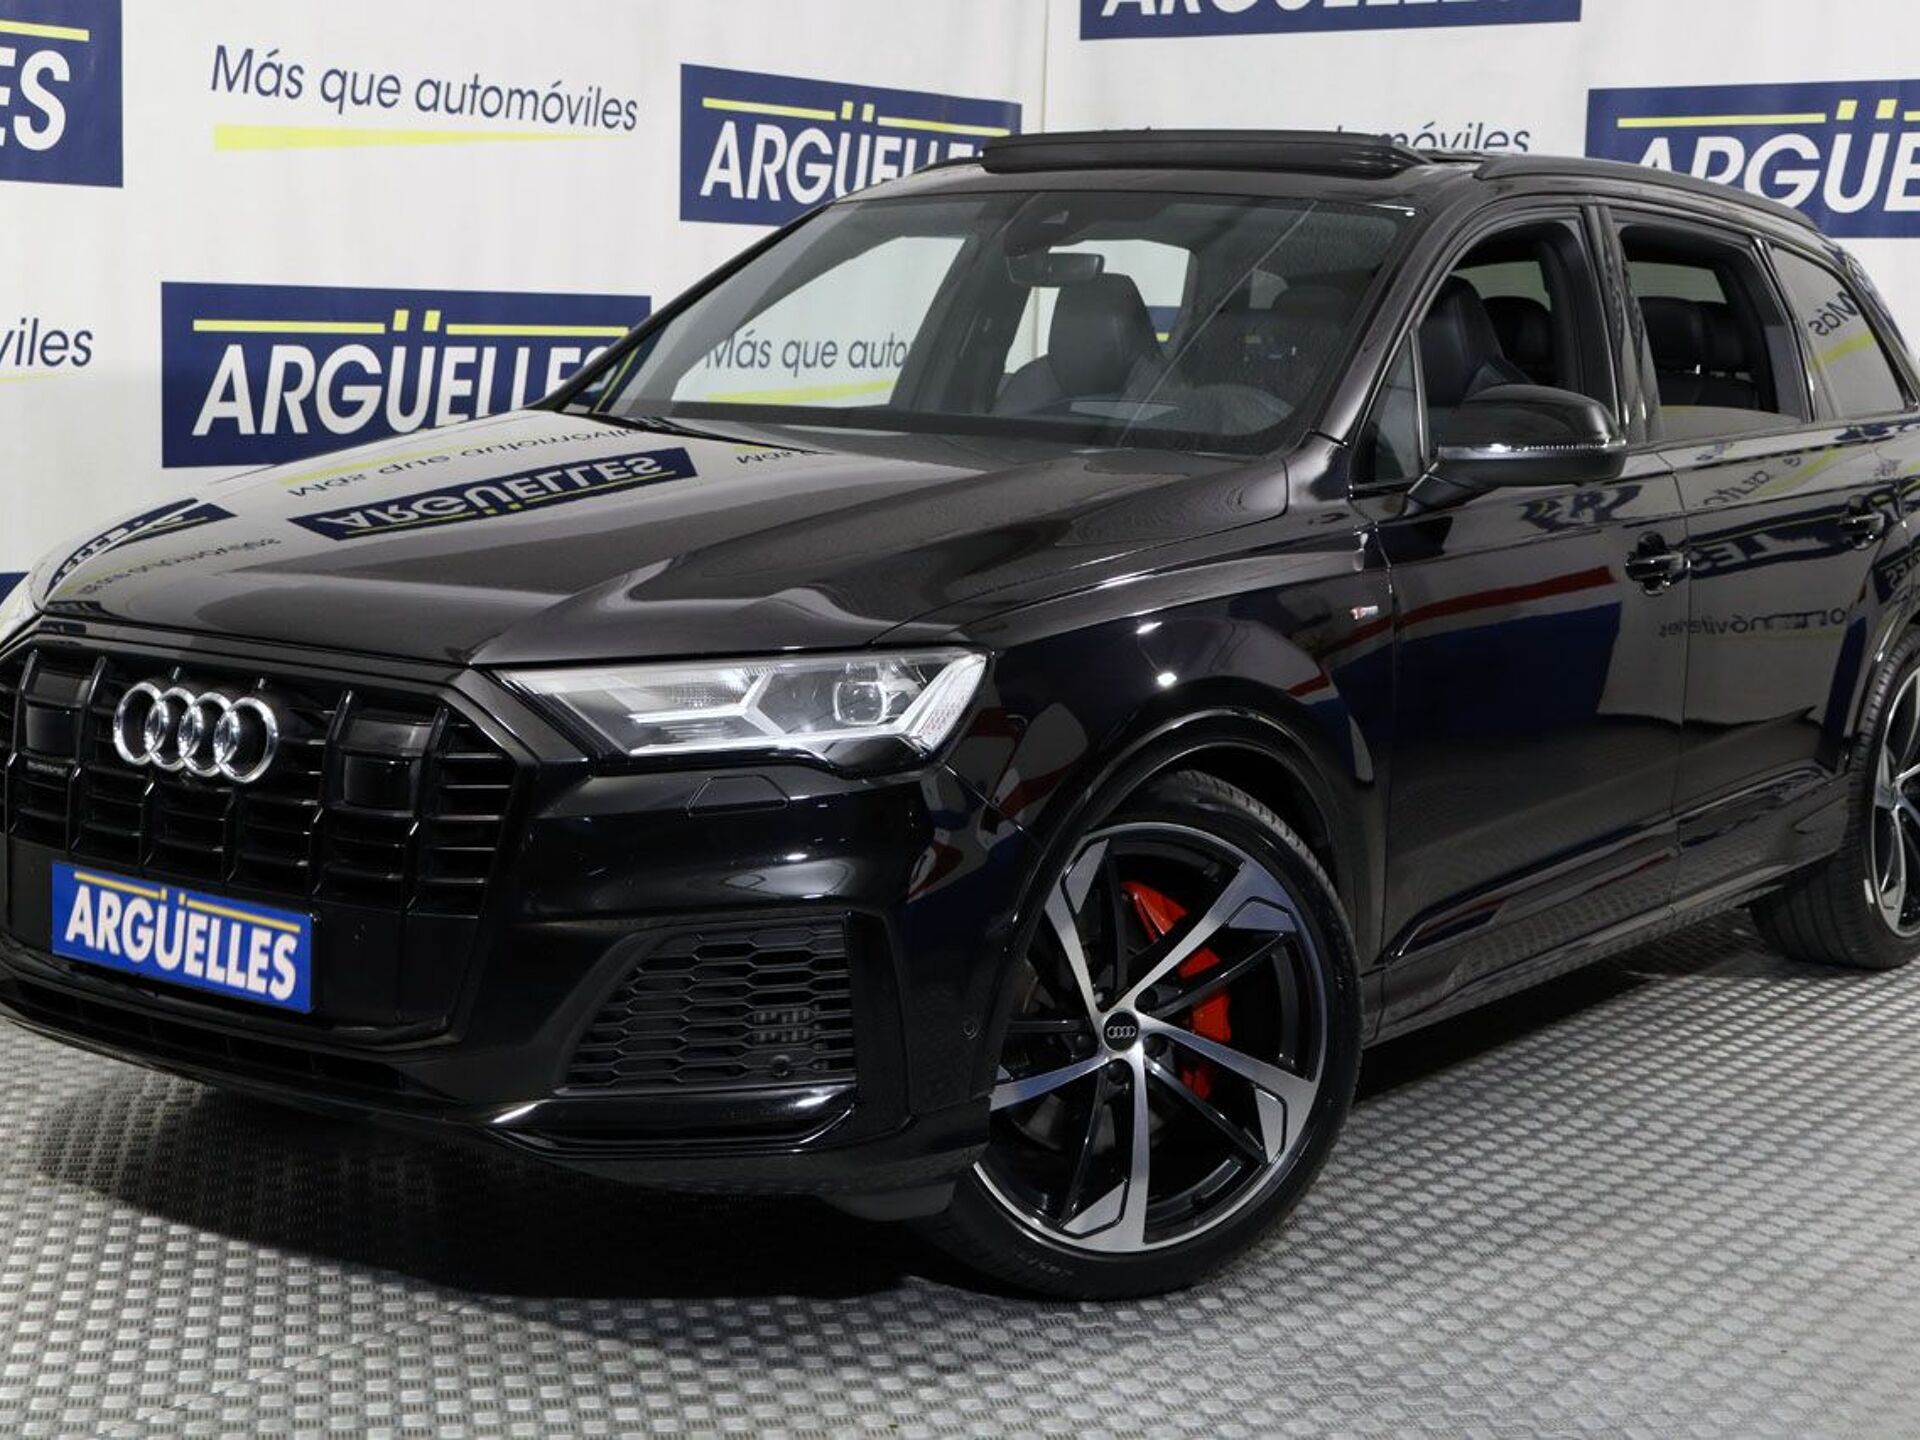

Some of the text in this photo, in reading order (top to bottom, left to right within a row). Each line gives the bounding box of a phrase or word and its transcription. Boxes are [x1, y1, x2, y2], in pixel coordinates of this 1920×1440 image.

[211, 45, 639, 131] Más que automóviles
[781, 339, 838, 379] que
[65, 885, 297, 1001] ARGÜELLES
